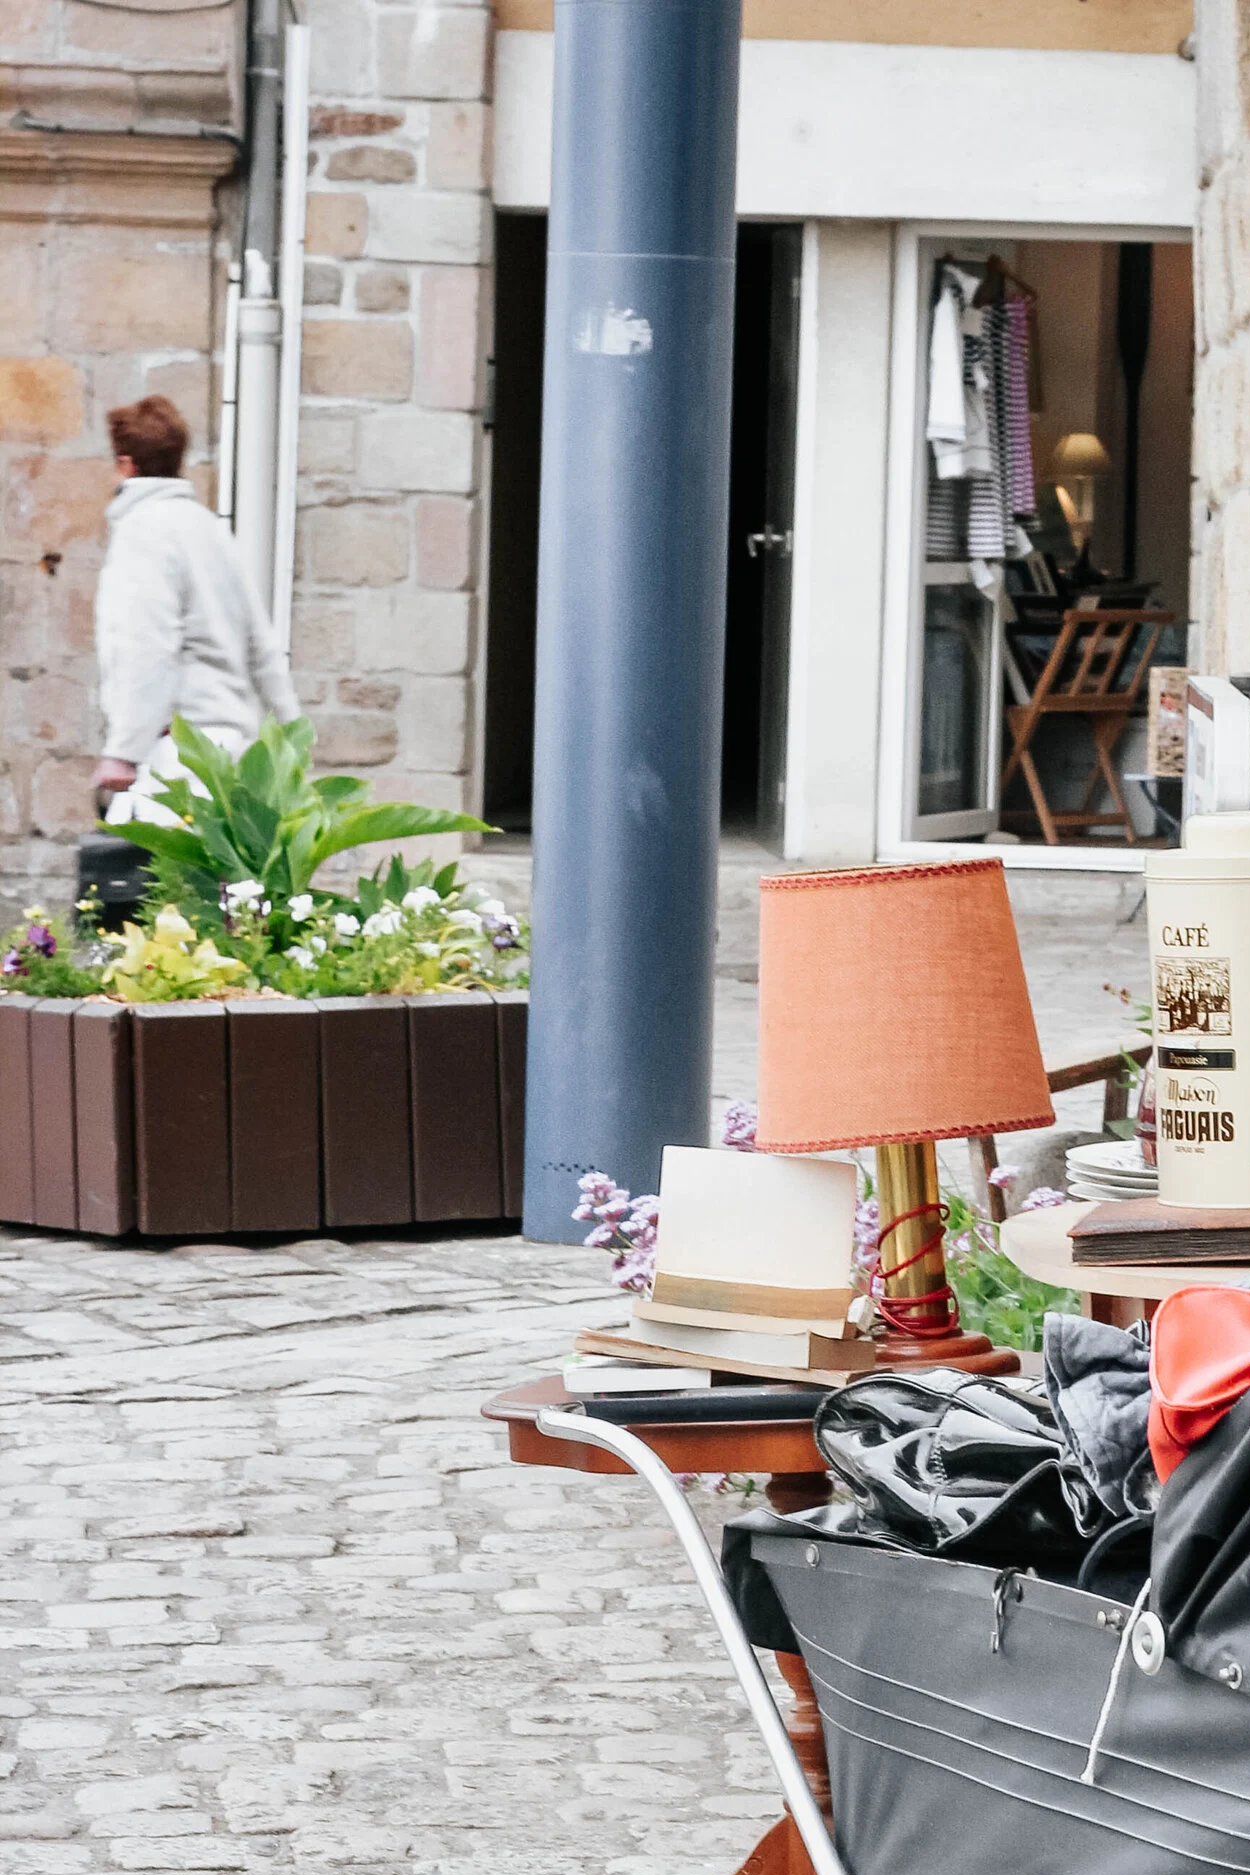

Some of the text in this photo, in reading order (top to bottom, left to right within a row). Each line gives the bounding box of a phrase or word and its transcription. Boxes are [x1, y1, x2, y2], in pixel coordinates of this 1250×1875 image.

[1162, 922, 1209, 948] CAFÉ
[1167, 1075, 1219, 1108] Maison
[1160, 1107, 1235, 1144] FAGUAIS
